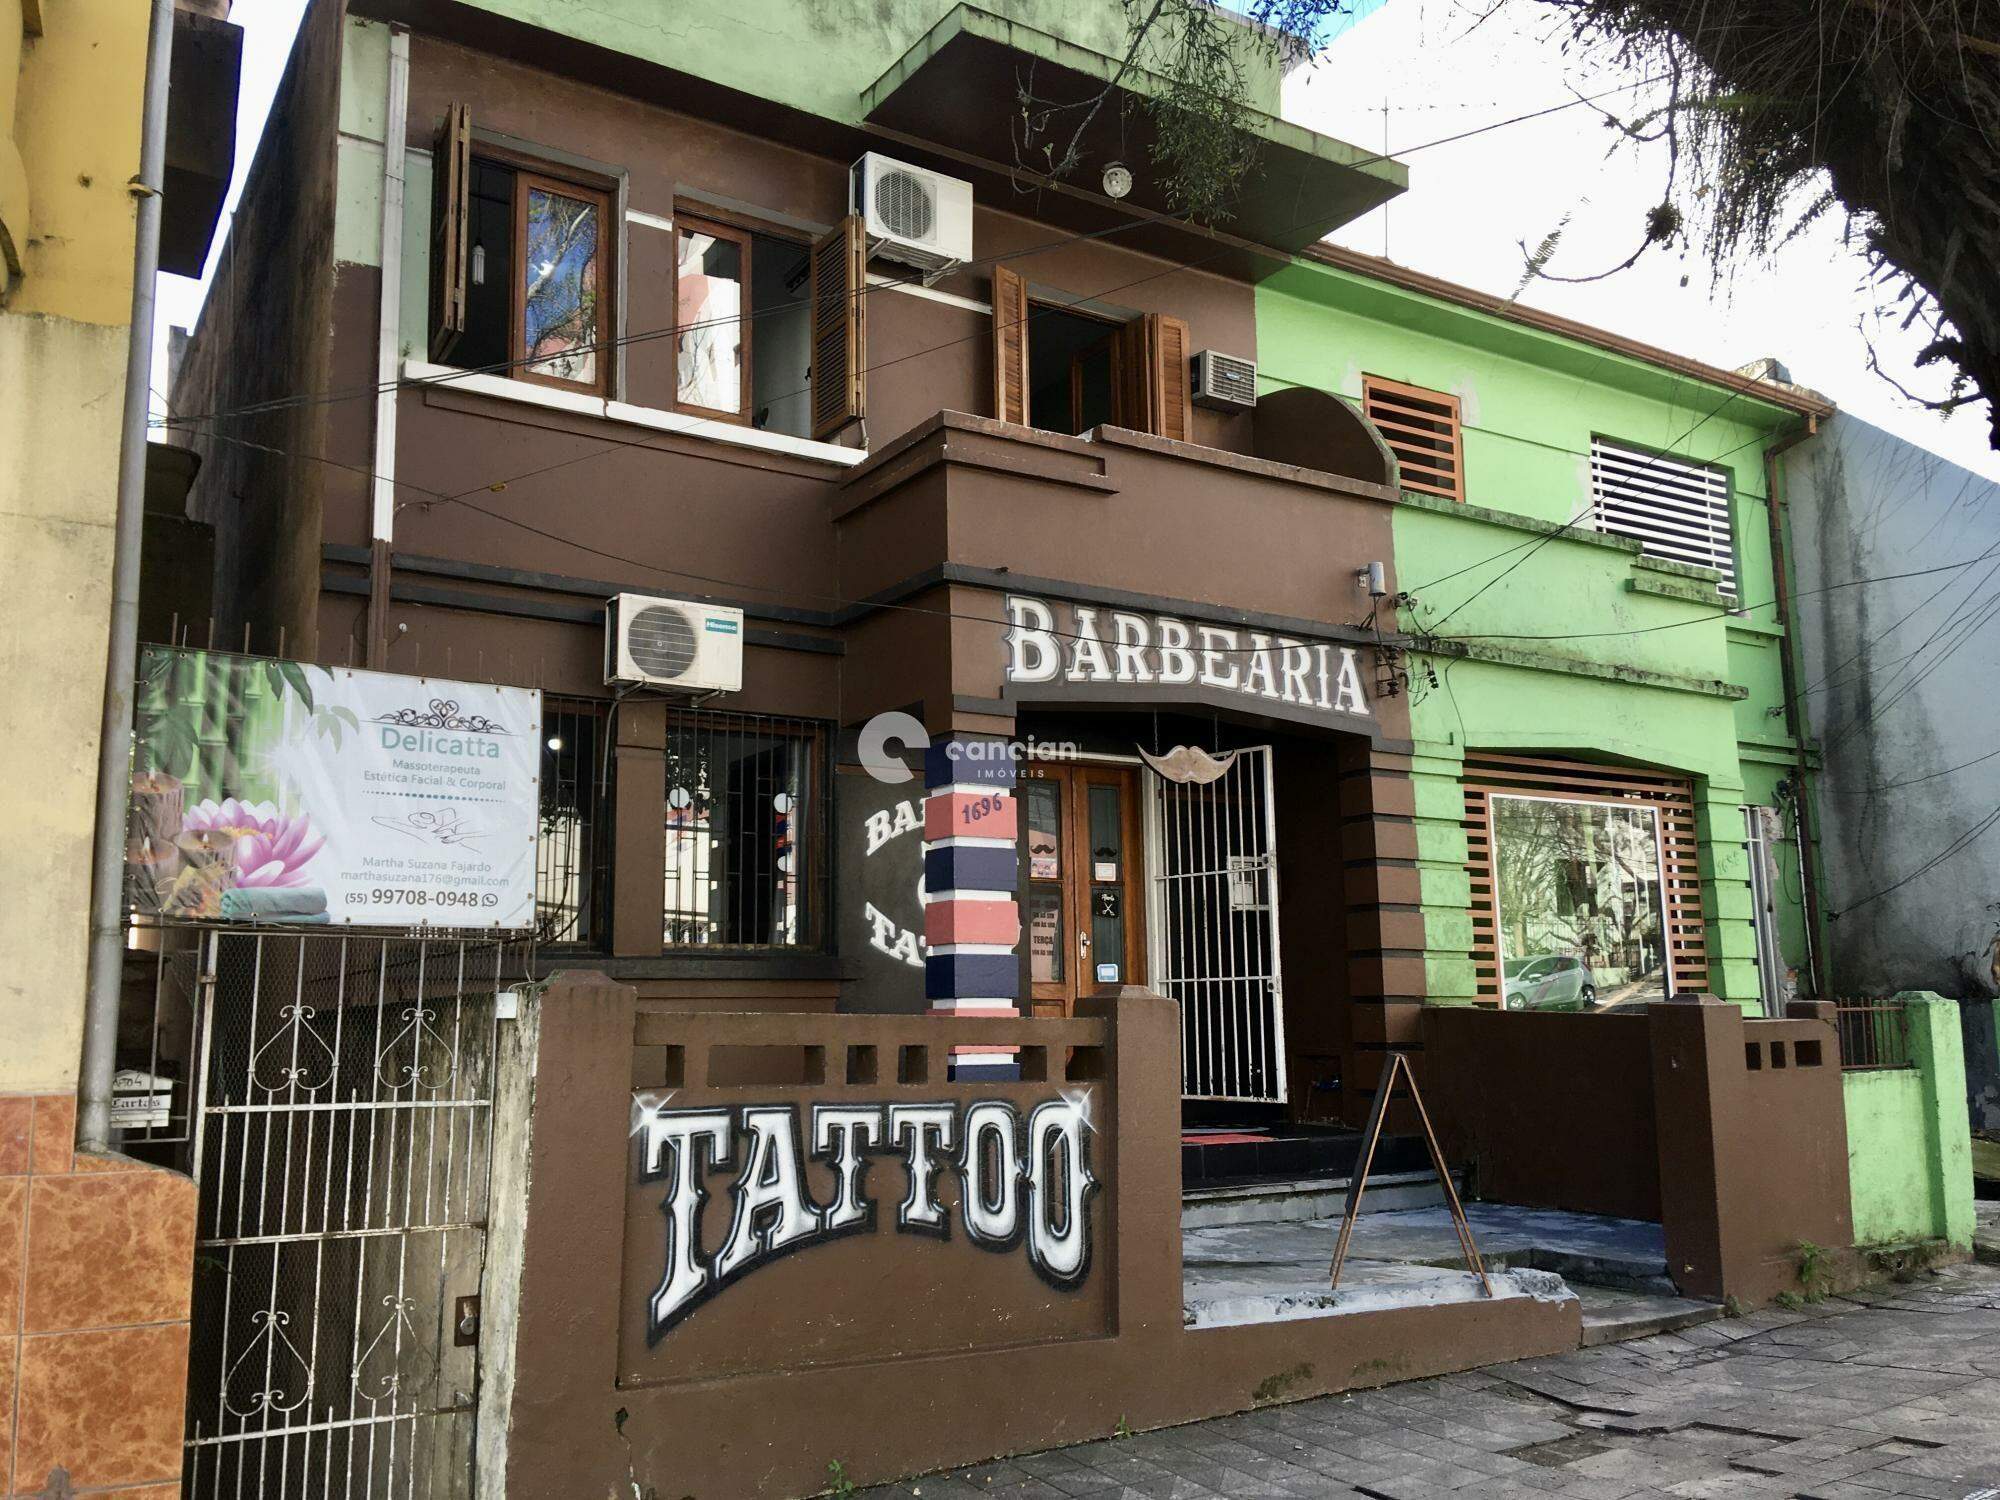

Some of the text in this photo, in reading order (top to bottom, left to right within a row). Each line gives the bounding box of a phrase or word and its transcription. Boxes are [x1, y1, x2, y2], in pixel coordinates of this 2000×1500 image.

[706, 620, 737, 631] Hisense
[1005, 593, 1371, 717] BARBEARIA
[381, 727, 500, 758] Delicatta
[392, 759, 481, 775] Massoterapeuta
[364, 770, 506, 790] Estética Facial & Corporal
[962, 792, 1002, 824] 1696
[362, 857, 492, 873] Martha Suzana Fajardo
[340, 871, 510, 887] marthasuzana176@gmail.com
[345, 888, 479, 907] (55) 99708-0948
[638, 1099, 1098, 1340] TATTOO
